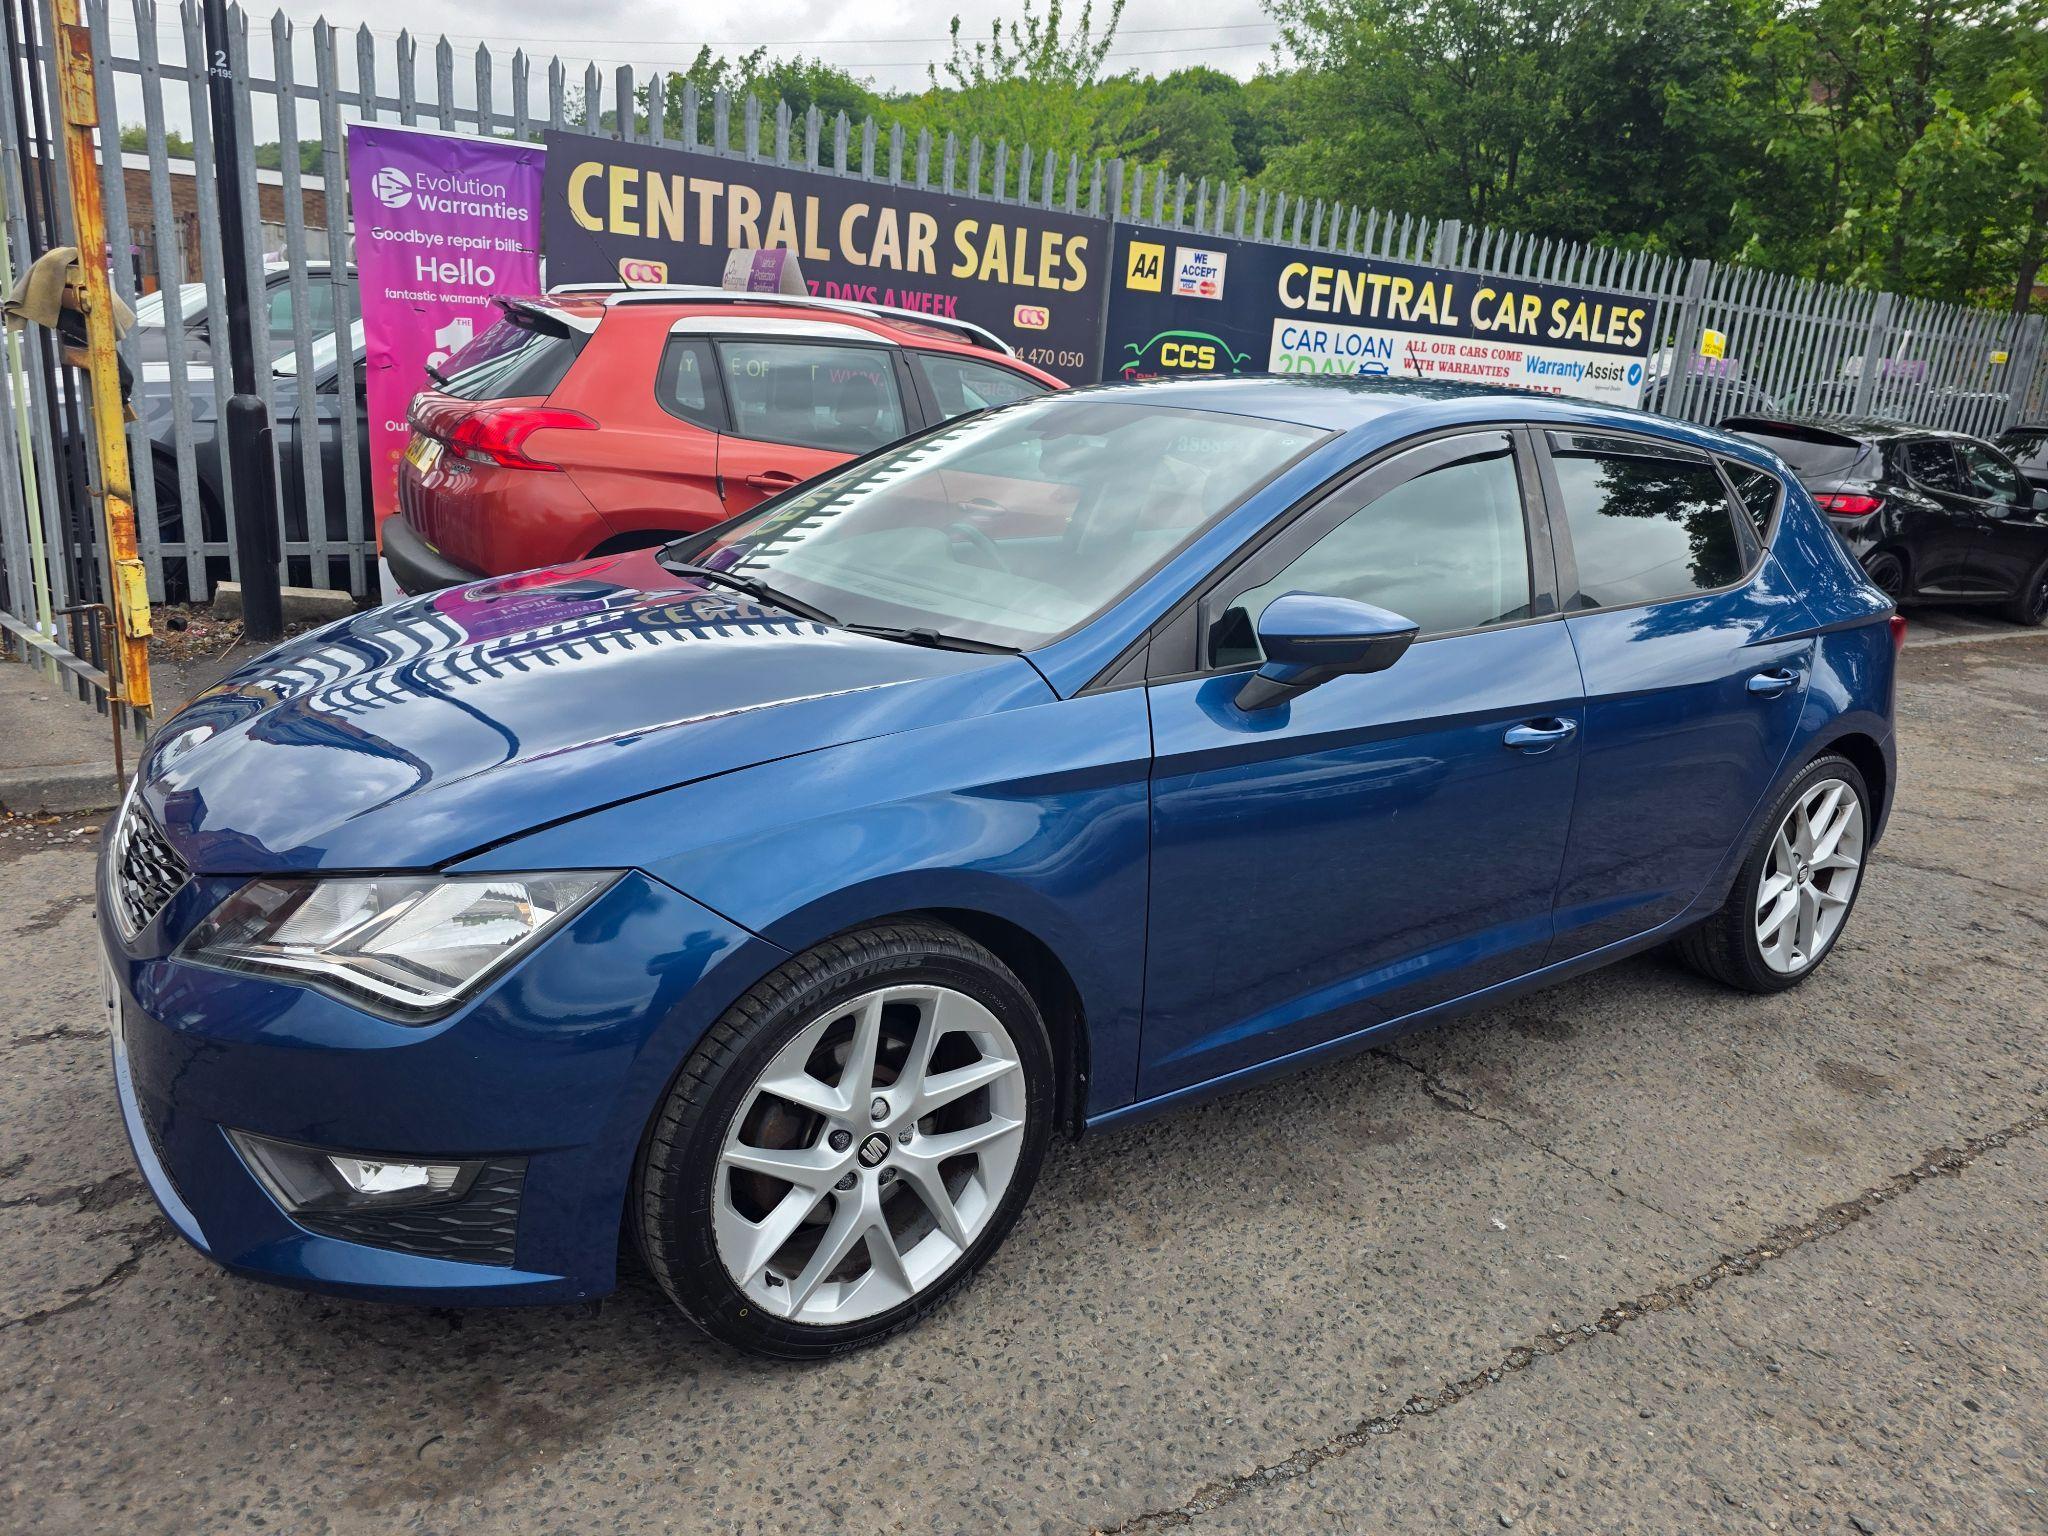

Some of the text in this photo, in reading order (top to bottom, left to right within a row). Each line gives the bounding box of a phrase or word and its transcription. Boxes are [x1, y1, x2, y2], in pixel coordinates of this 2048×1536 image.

[215, 50, 227, 68] 2
[416, 172, 506, 199] Evolution
[416, 194, 529, 222] Warranties
[371, 227, 444, 248] Goodbye
[447, 235, 492, 251] repair
[568, 161, 1088, 292] CENTRAL CAR SALES
[1132, 253, 1159, 280] AA
[1194, 252, 1208, 265] WE
[415, 256, 496, 287] Hello
[1181, 264, 1217, 279] ACCEPT
[384, 288, 492, 307] fantastic warranty
[825, 281, 878, 305] DAYS
[884, 288, 896, 307] A
[901, 290, 958, 320] WEEK
[1278, 262, 1646, 348] CENTRAL CAR SALES
[1281, 326, 1394, 360] CAR LOAN
[1405, 340, 1522, 362] ALL OUR CARS COME
[1029, 348, 1055, 365] 470
[1058, 351, 1084, 368] 050
[1161, 342, 1216, 370] CCS
[1403, 358, 1510, 377] WITH WARRANTIES
[385, 420, 409, 432] Our
